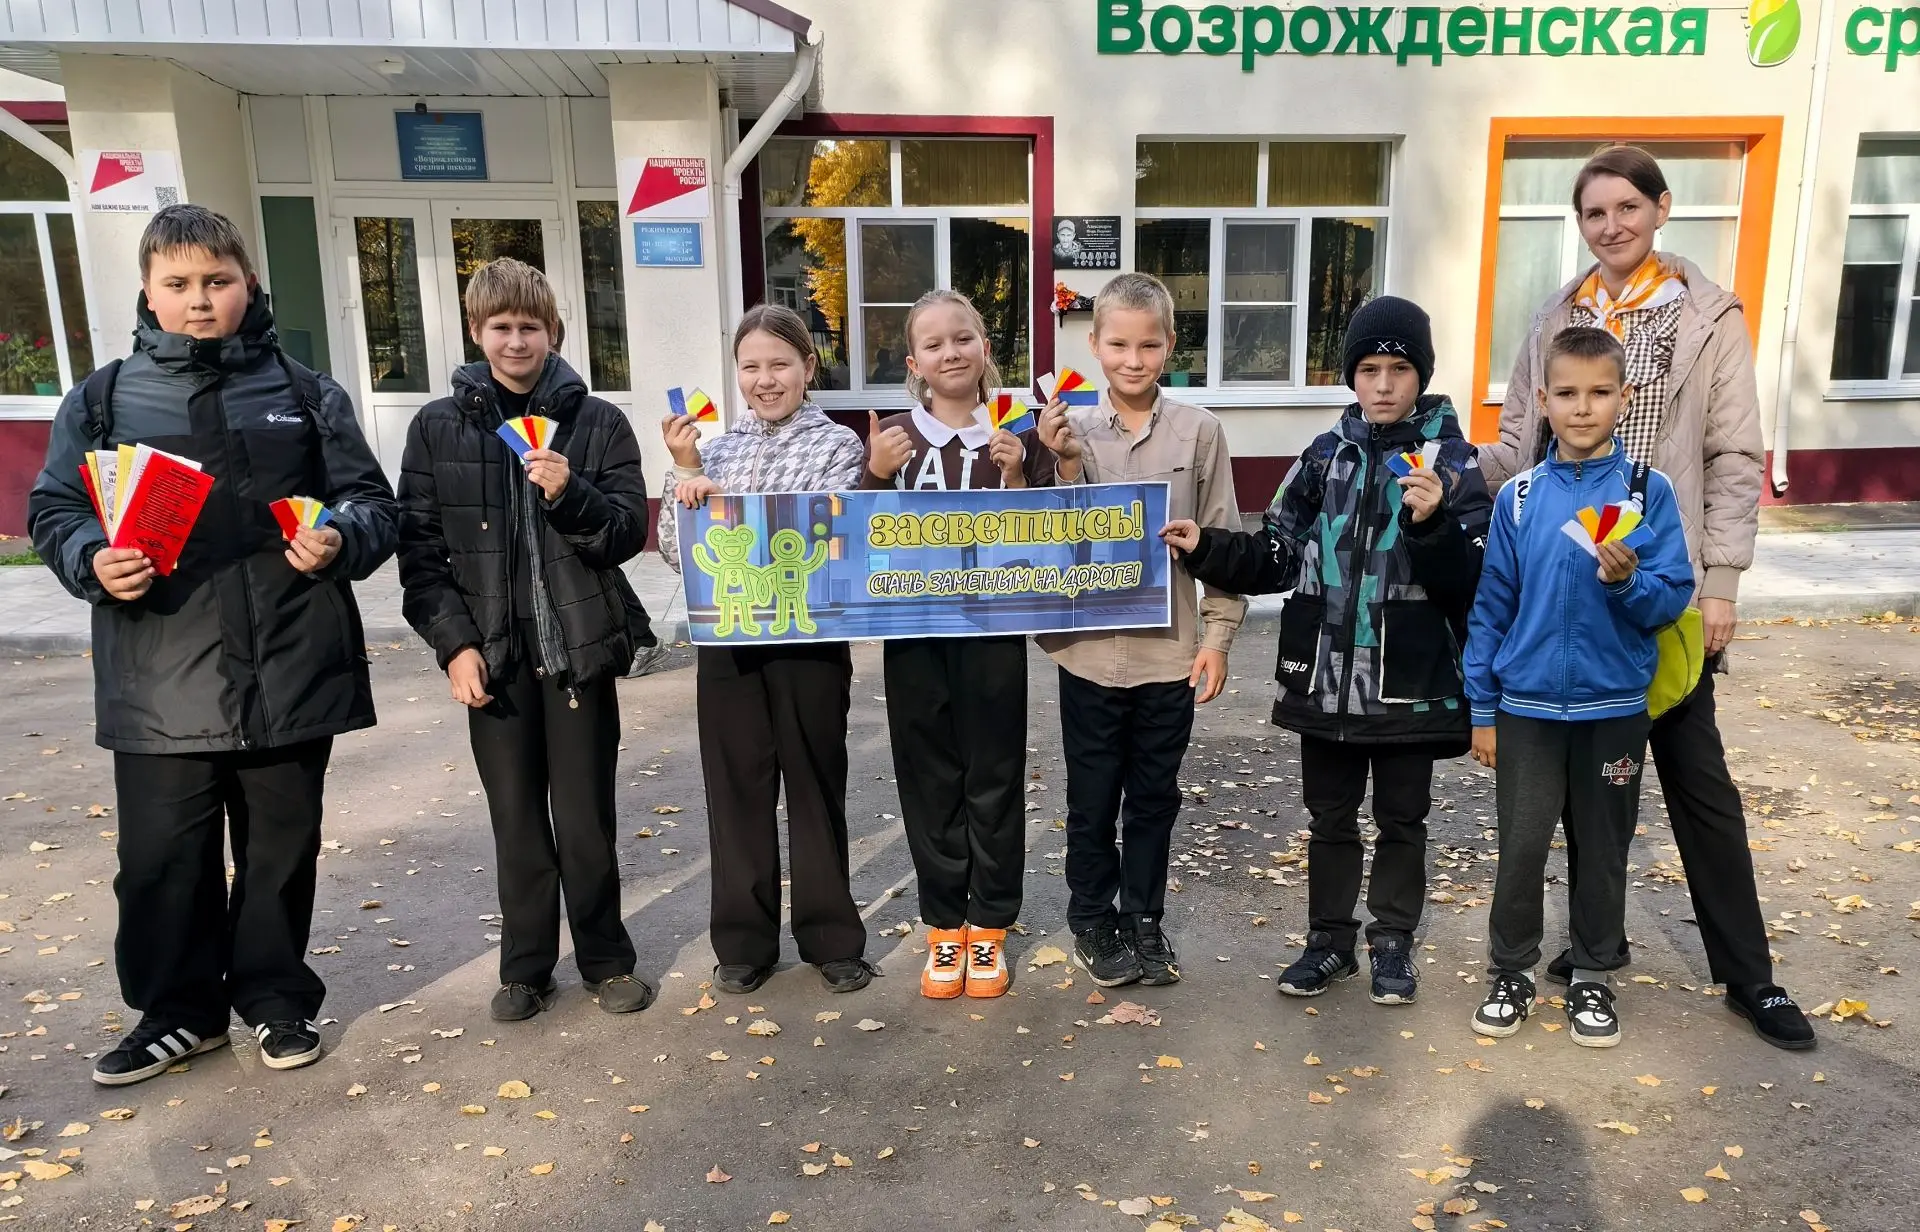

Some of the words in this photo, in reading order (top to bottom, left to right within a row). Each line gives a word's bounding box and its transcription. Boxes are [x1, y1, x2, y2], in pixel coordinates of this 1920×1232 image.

[1097, 0, 1709, 72] Возрожденская
[649, 158, 704, 168] НАЦИОНАЛЬНЫЕ
[673, 168, 705, 176] ПРОЕКТЫ
[680, 177, 705, 185] РОССИИ
[869, 573, 926, 595] СТАНЬ
[930, 569, 1030, 593] ЗАМЕТНЫМ
[1034, 567, 1059, 589] НА
[1061, 563, 1140, 595] ДОРОГЕ!
